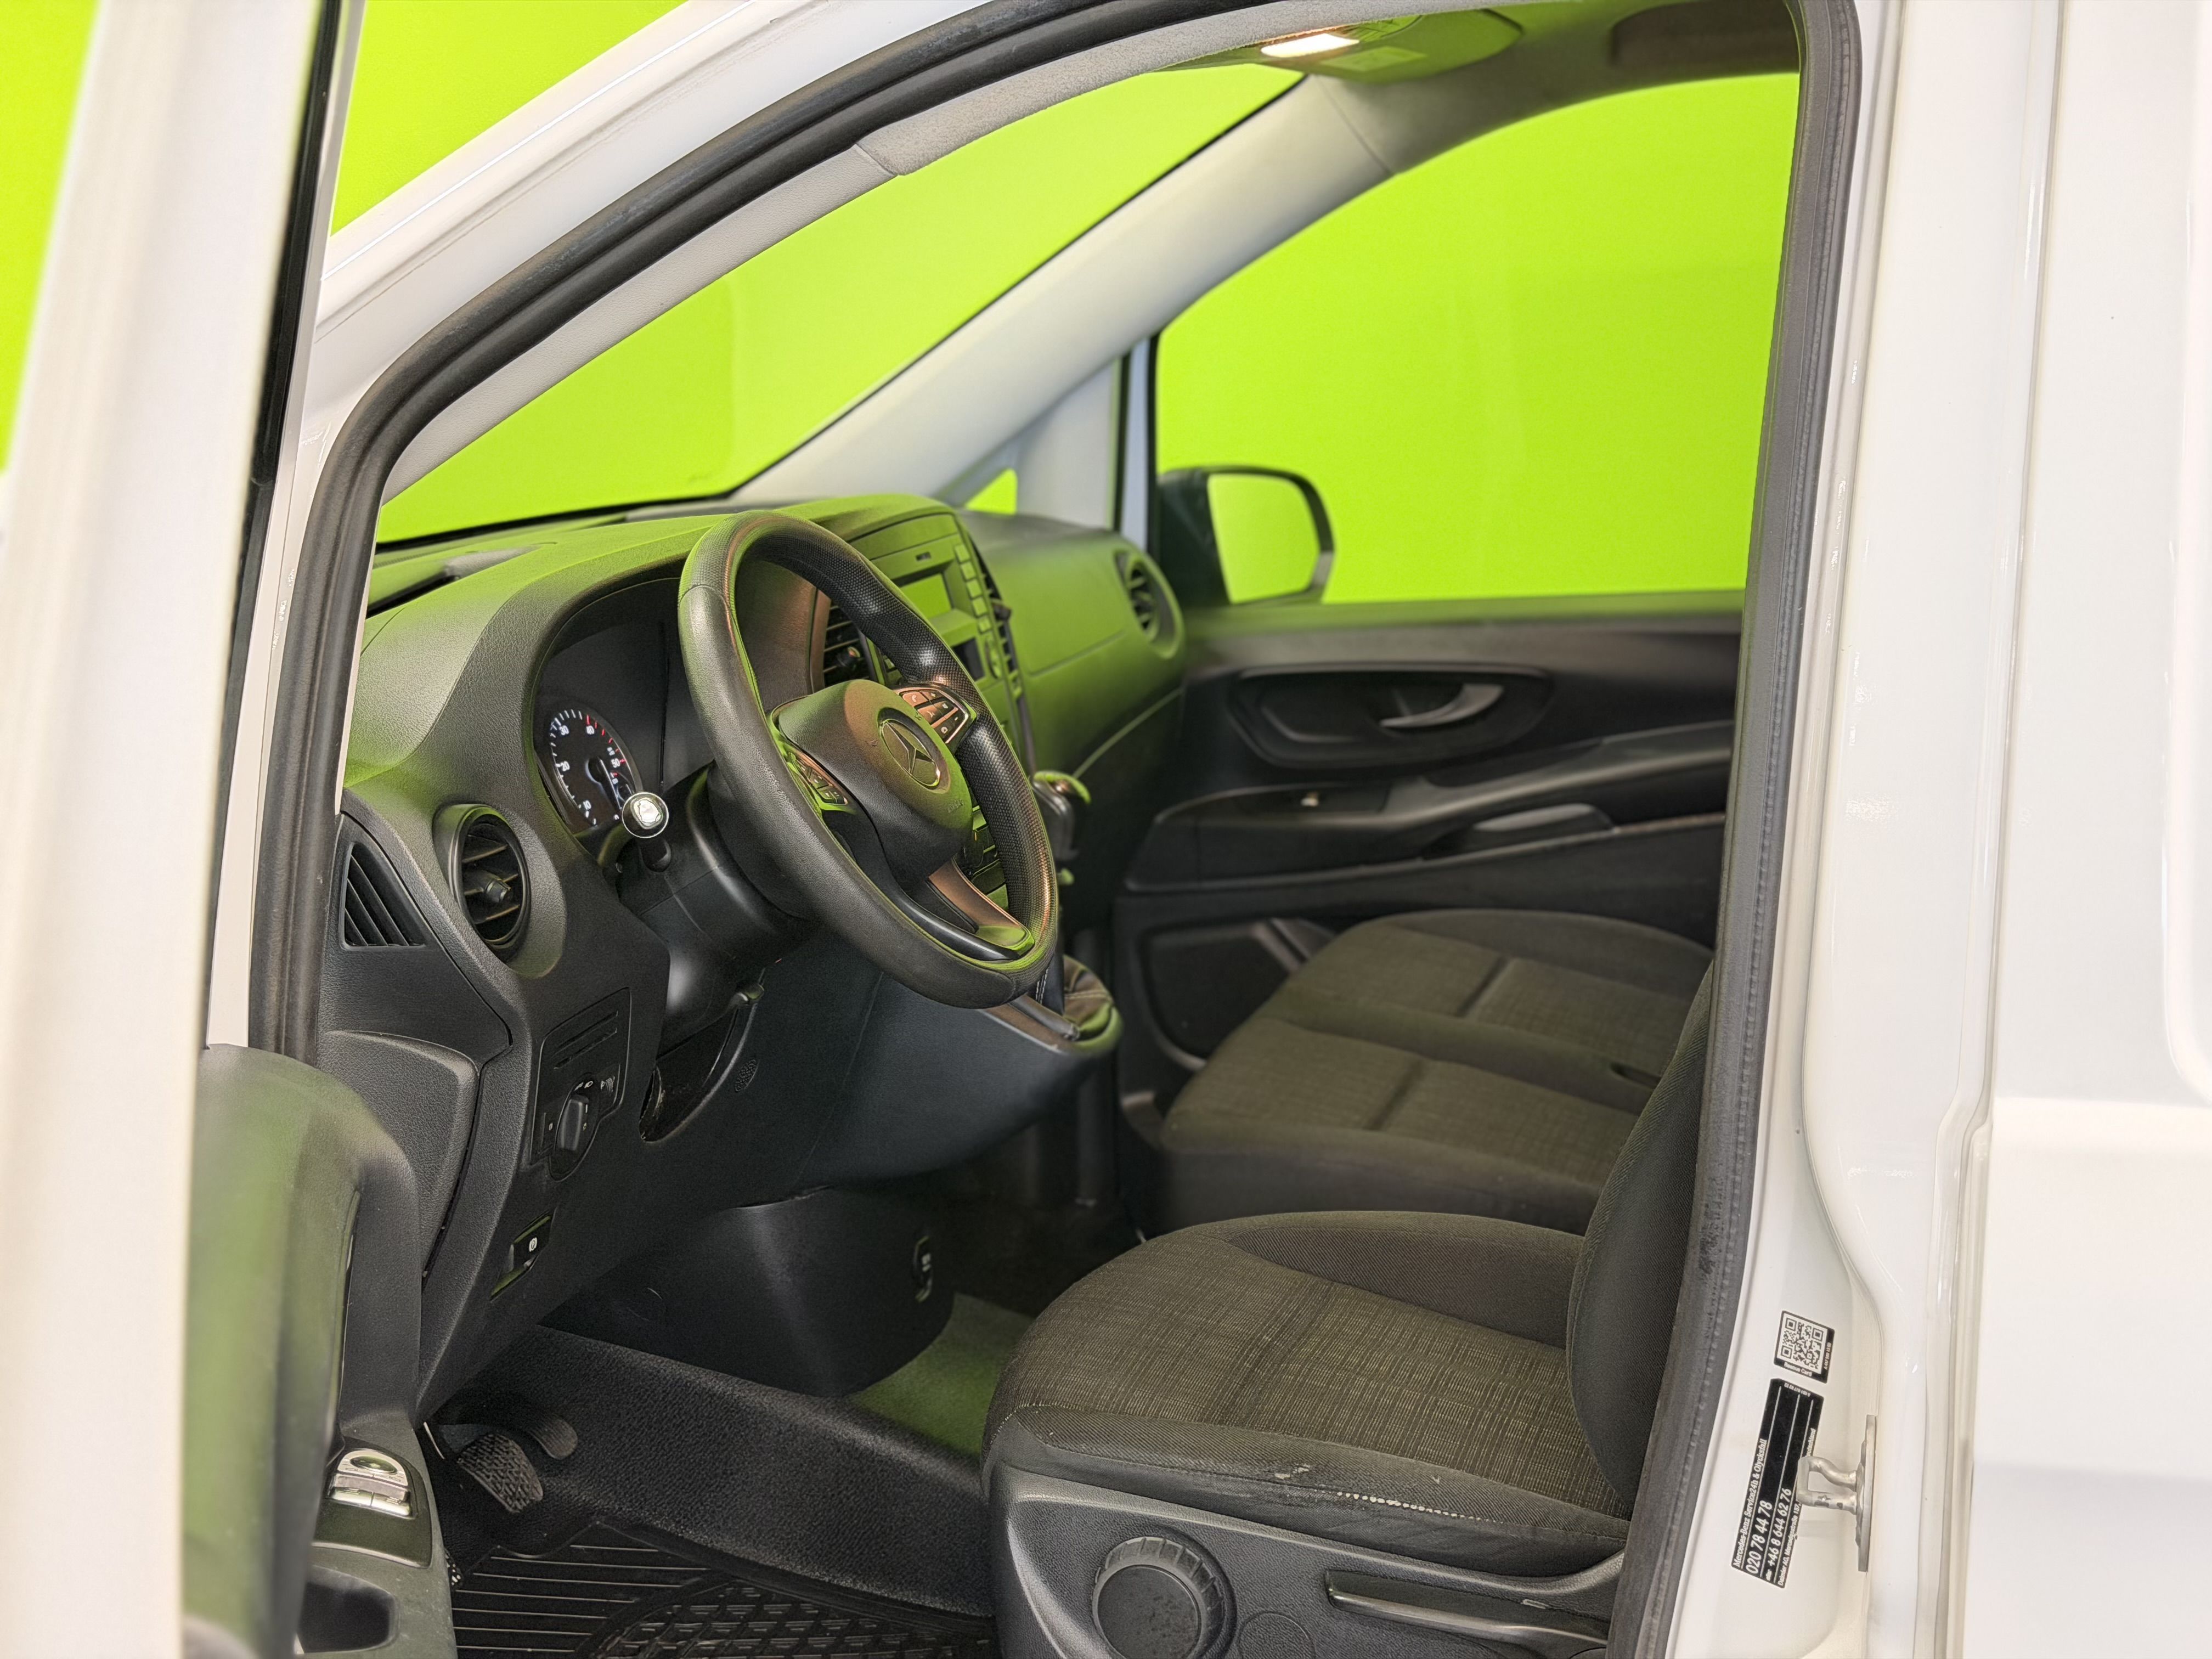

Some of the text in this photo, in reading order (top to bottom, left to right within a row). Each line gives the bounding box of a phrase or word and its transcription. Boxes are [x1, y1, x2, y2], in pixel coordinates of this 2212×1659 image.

[559, 726, 569, 735] 30
[586, 726, 595, 735] 40
[561, 761, 569, 771] 20
[611, 758, 620, 768] 50
[583, 800, 591, 810] 10
[1801, 1368, 1812, 1376] Card
[1780, 1488, 1792, 1502] 76
[1733, 1517, 1750, 1567] Mercedes-Benz
[1744, 1480, 1758, 1517] Service24h
[1754, 1438, 1767, 1472] Olycksfall
[1778, 1565, 1787, 1586] Daimler
[1805, 1428, 1816, 1458] eutschland
[1778, 1503, 1788, 1516] 62
[1773, 1518, 1785, 1537] 644
[1746, 1500, 1773, 1574] 020 78 44 78
[1768, 1547, 1779, 1566] +46
